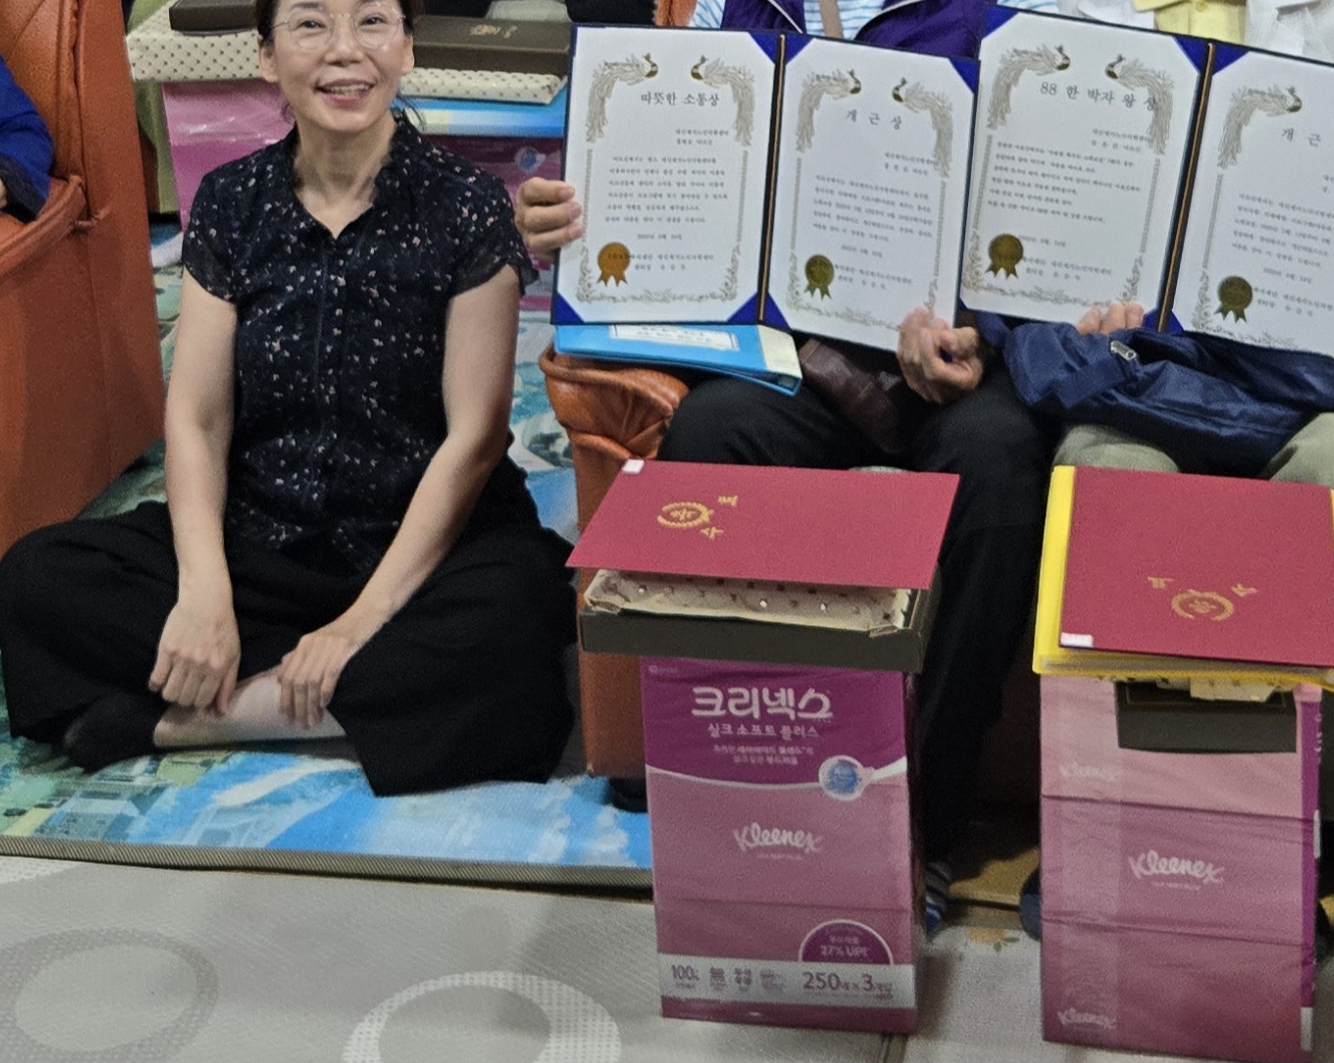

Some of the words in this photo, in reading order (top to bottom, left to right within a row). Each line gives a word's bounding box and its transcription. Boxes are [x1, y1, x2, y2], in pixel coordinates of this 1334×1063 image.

[640, 92, 677, 107] 따뜻한
[683, 92, 720, 107] 소통상
[1039, 81, 1058, 96] 88
[1066, 84, 1080, 100] 한
[1087, 88, 1115, 105] 박자
[690, 686, 834, 721] 크리넥스
[707, 723, 734, 739] 실크
[736, 724, 777, 737] 소프트
[780, 725, 820, 741] 플러스
[732, 822, 823, 855] Kleenex
[1127, 848, 1225, 885] Kleenex
